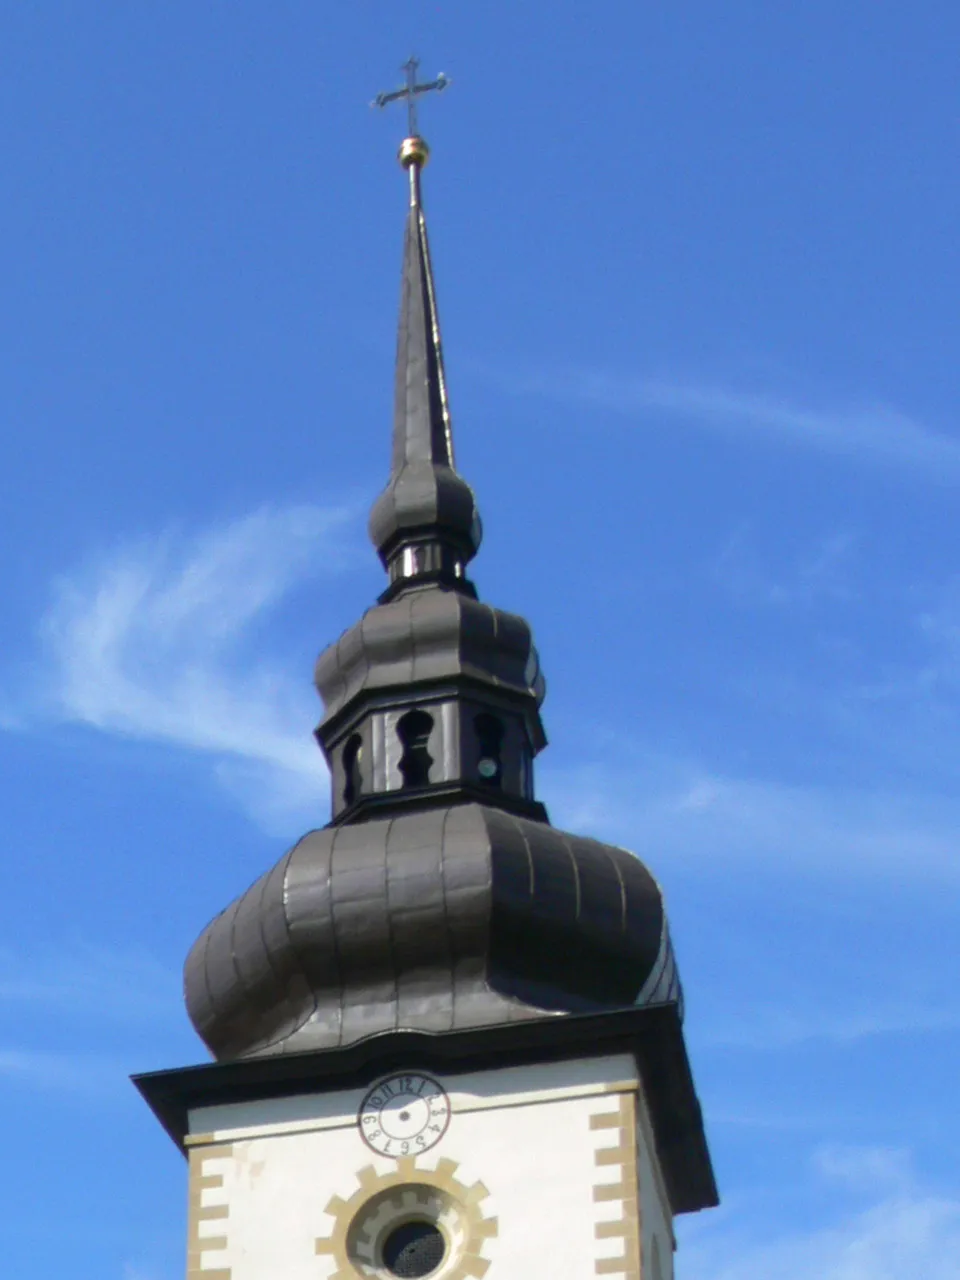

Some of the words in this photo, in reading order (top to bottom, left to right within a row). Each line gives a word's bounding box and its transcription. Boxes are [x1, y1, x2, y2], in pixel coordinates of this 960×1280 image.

[399, 1078, 413, 1091] 12
[418, 1080, 426, 1095] 1
[381, 1084, 395, 1098] 11
[367, 1097, 382, 1109] 10
[428, 1092, 441, 1105] 2
[431, 1108, 446, 1116] 3
[363, 1116, 376, 1124] 9
[428, 1124, 440, 1133] 4
[368, 1130, 381, 1141] 8
[384, 1140, 392, 1152] 7
[401, 1141, 409, 1154] 6
[416, 1136, 427, 1148] 5
